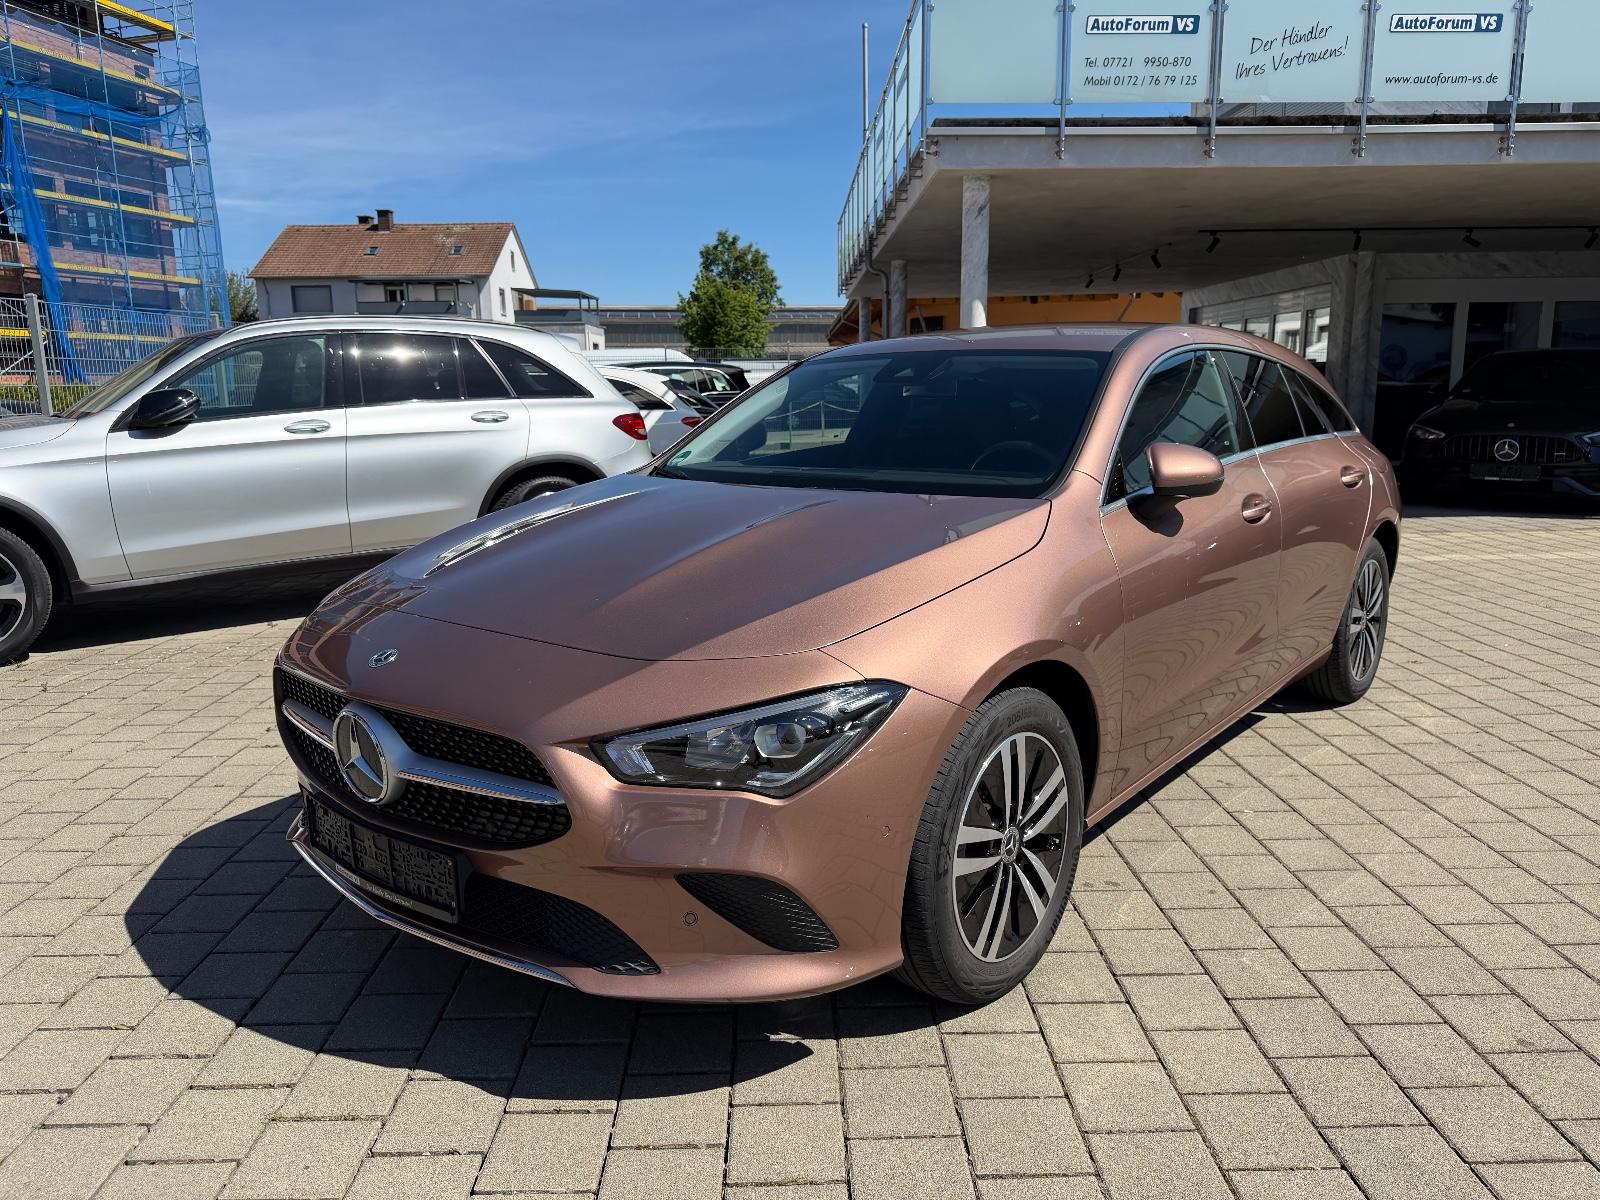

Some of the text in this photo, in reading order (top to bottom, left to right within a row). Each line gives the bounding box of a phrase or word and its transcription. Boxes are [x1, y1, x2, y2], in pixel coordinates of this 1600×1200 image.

[1090, 17, 1195, 32] AutoForum VS
[1394, 15, 1498, 30] AutoForum VS
[1250, 20, 1333, 56] Der Händler
[1084, 56, 1192, 68] Tel. 07721 9950-870
[1235, 35, 1349, 80] Ihres Vertrauens!
[1084, 76, 1111, 86] Mobil
[1113, 76, 1139, 86] 0172
[1148, 76, 1161, 86] 76
[1164, 76, 1177, 86] 79
[1179, 75, 1197, 86] 125
[1385, 73, 1499, 86] www.autoforum-vs.de
